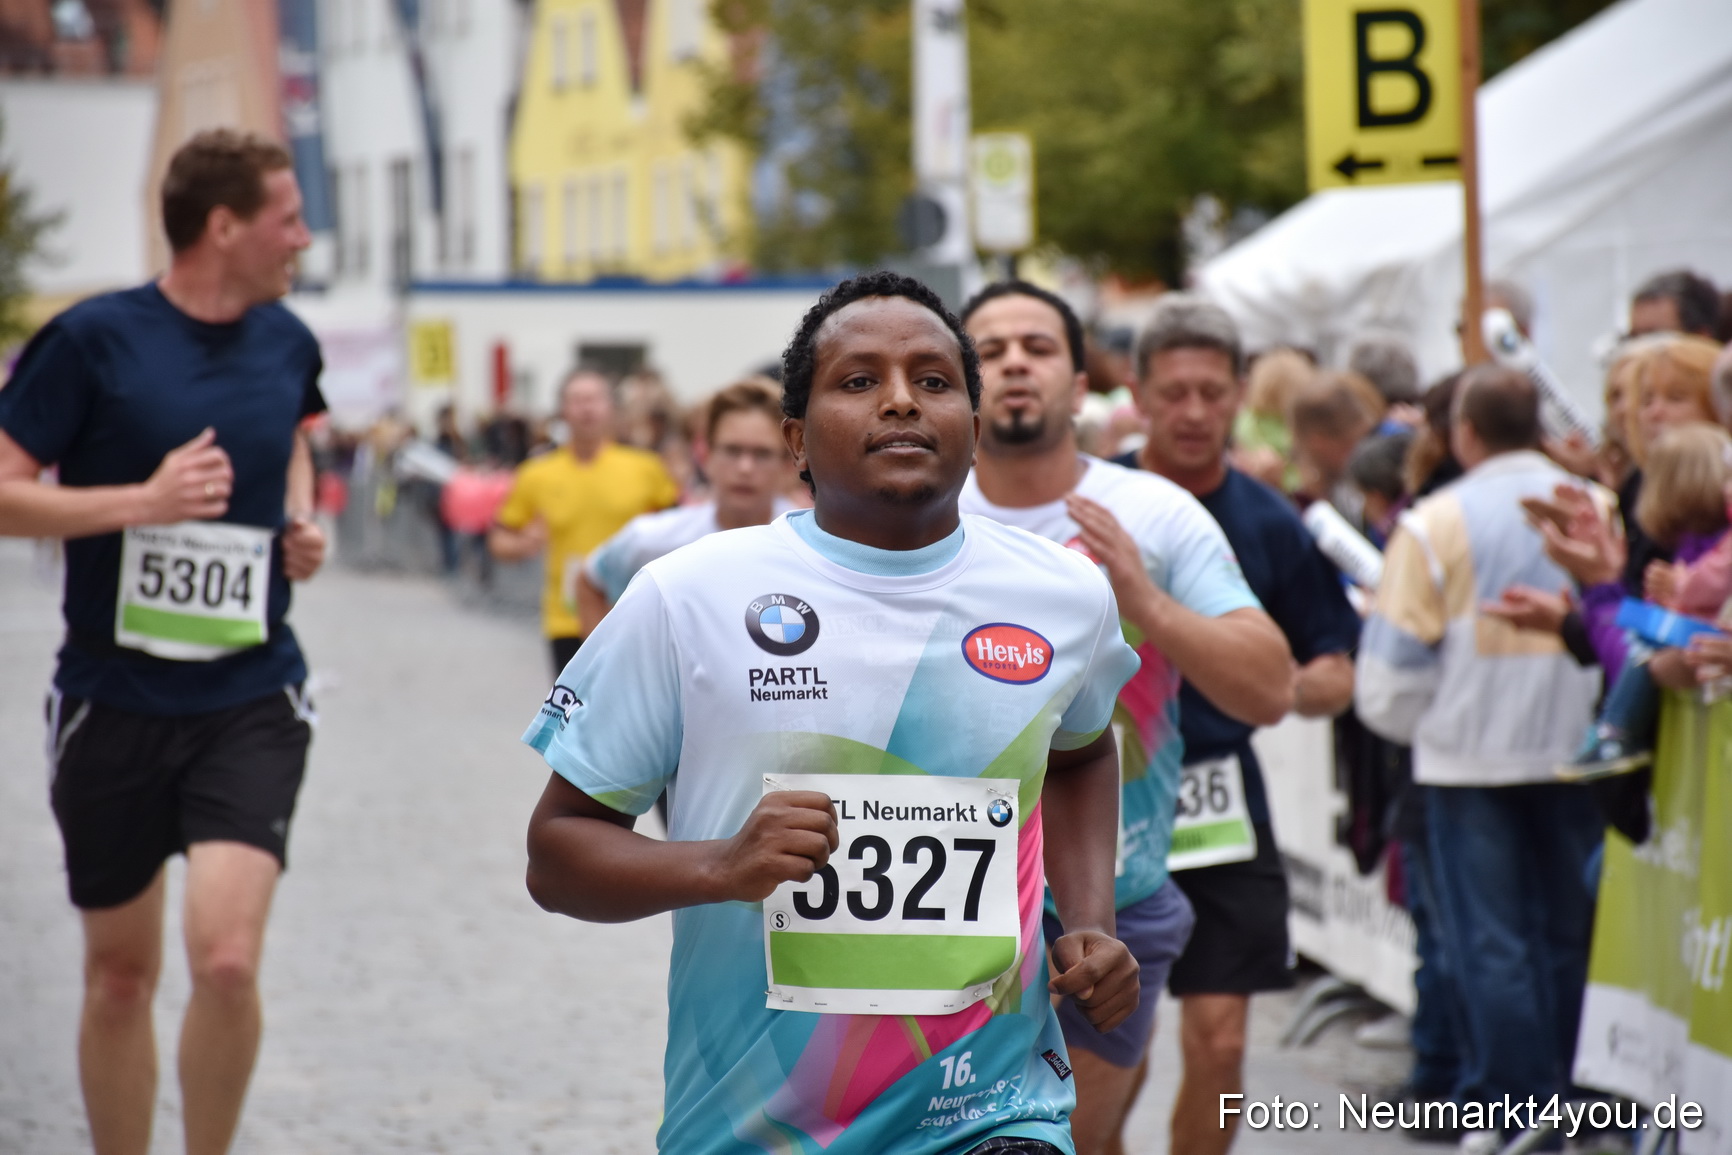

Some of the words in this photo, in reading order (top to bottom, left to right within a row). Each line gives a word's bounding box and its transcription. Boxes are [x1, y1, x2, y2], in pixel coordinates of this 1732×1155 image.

[1356, 10, 1432, 127] B
[139, 553, 252, 611] 5304
[750, 595, 811, 615] BMW
[975, 637, 1045, 669] Hervis
[983, 662, 1018, 671] SPORTS
[749, 667, 828, 687] PARTL
[750, 687, 828, 702] Neumarkt
[1176, 768, 1230, 817] 36
[863, 800, 978, 823] Neumarkt
[792, 835, 996, 921] 5327
[775, 914, 784, 928] S
[940, 1051, 976, 1090] 16.
